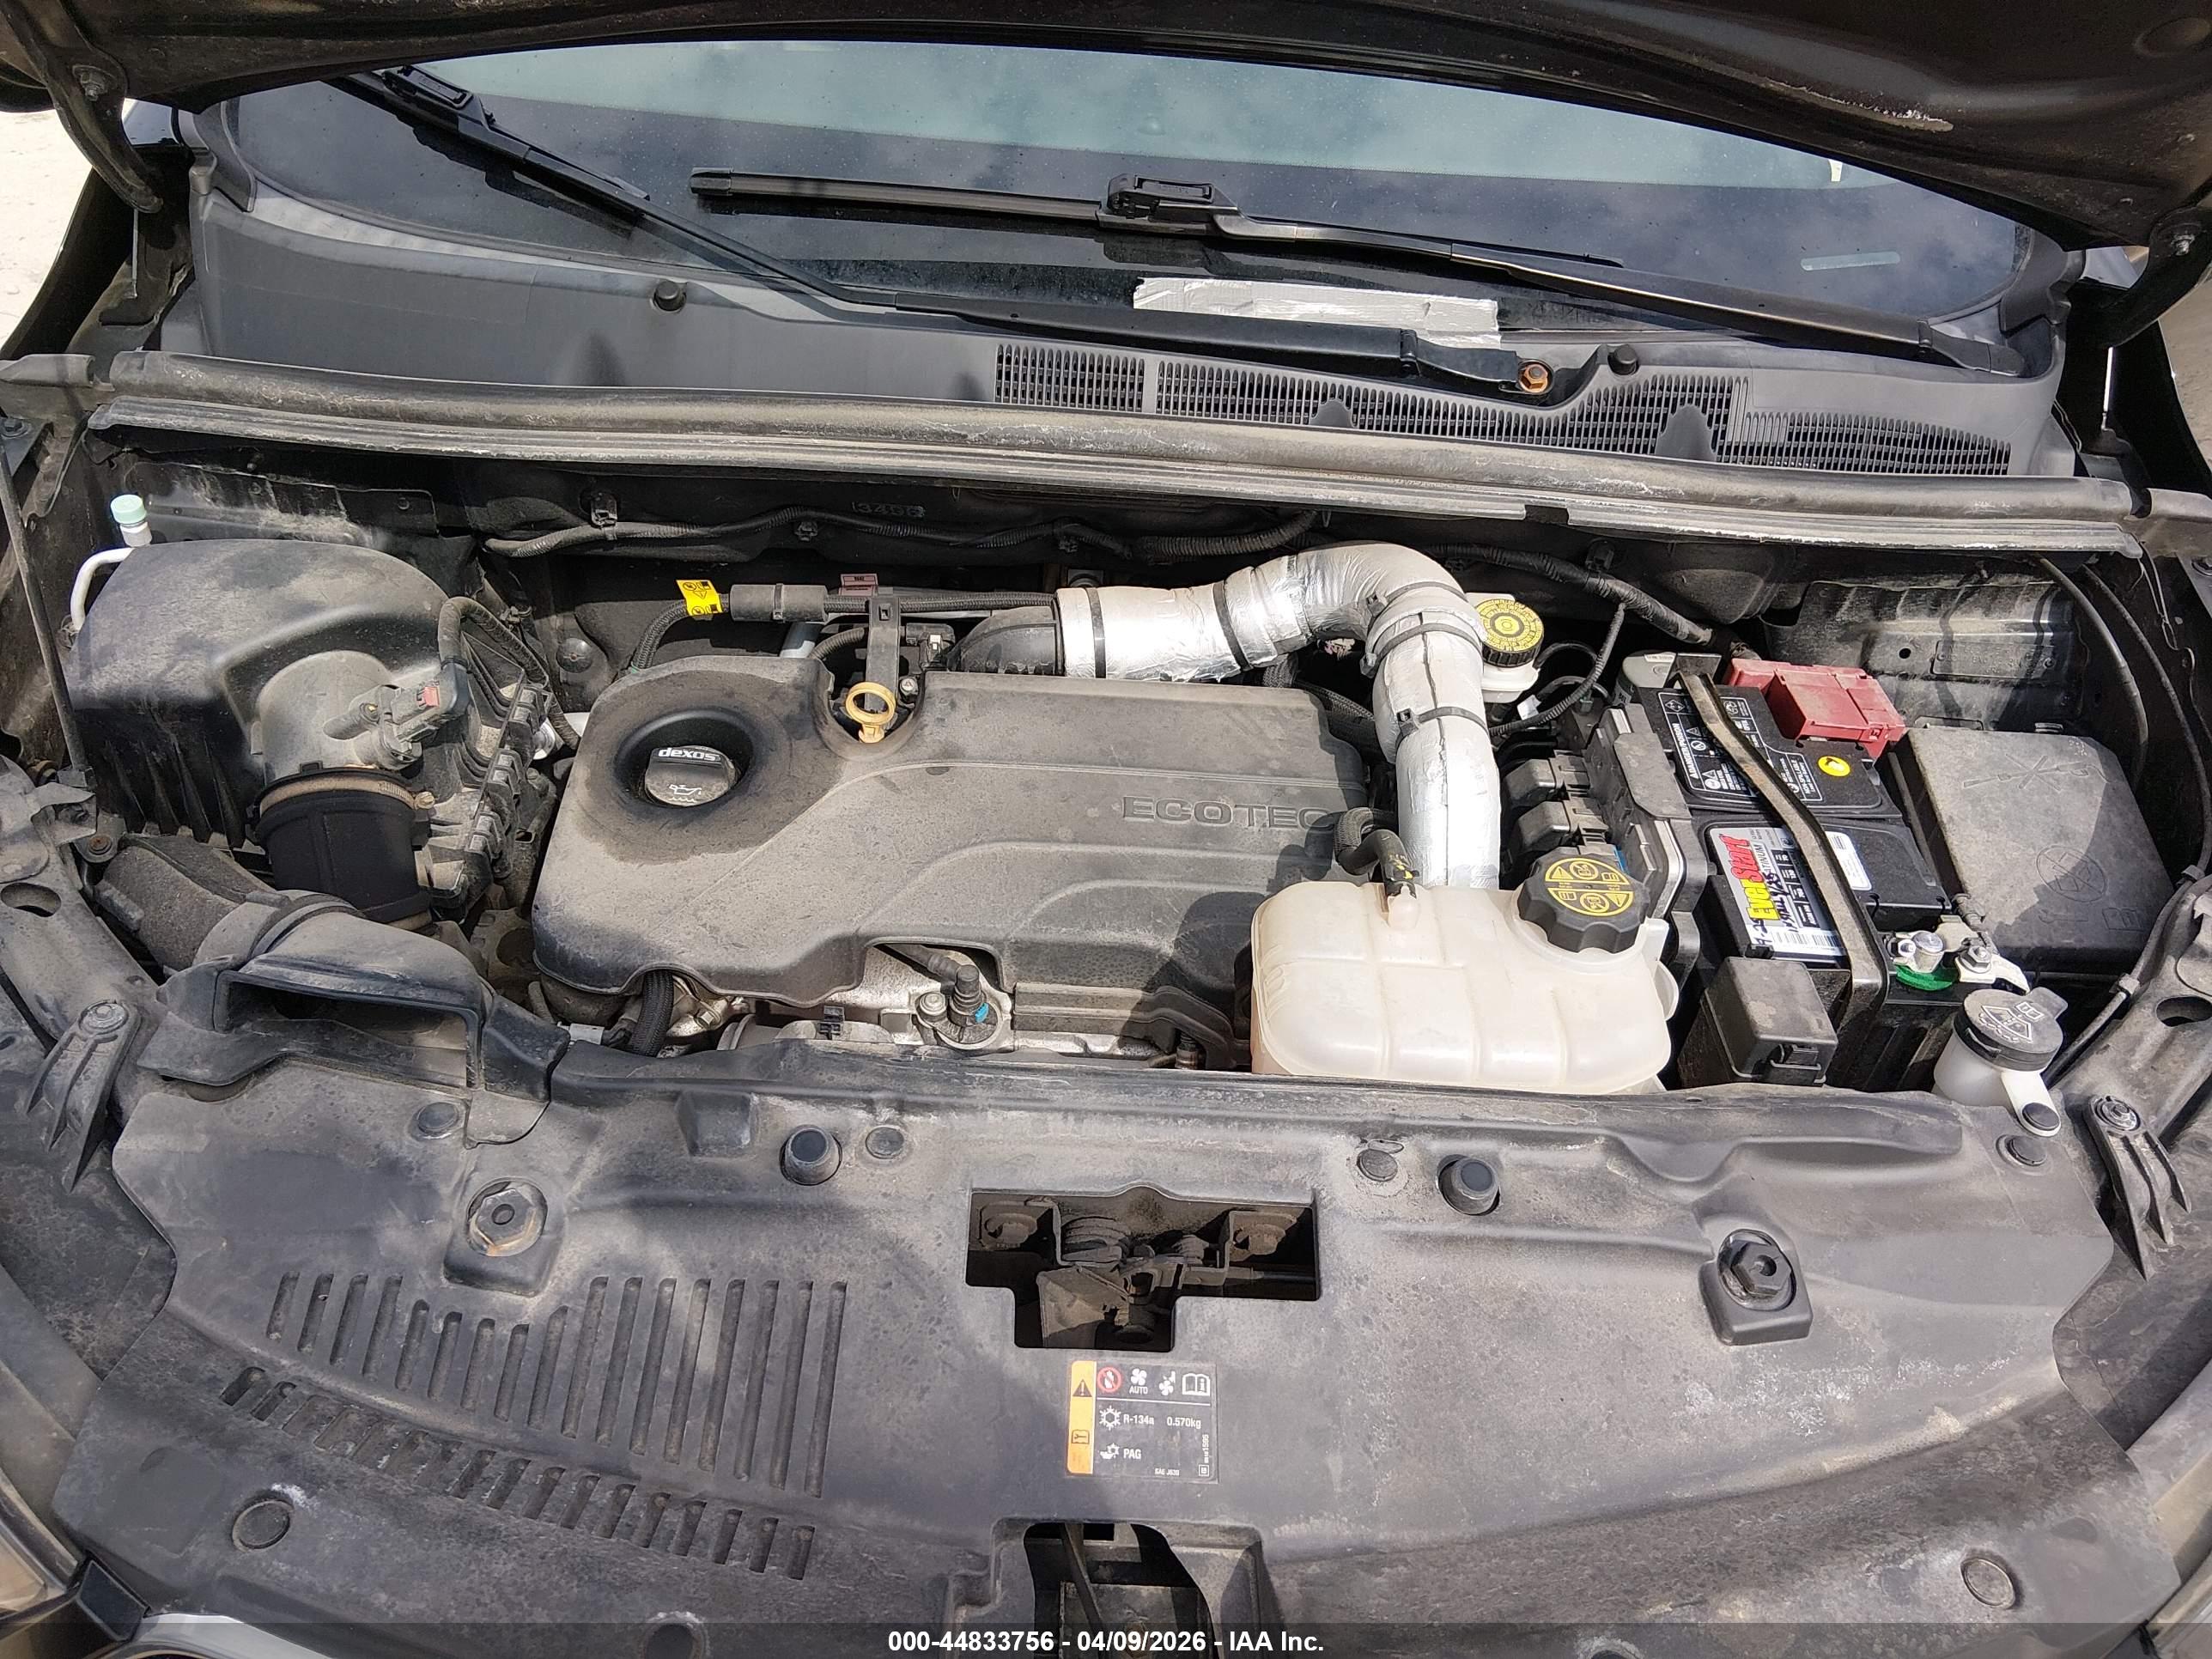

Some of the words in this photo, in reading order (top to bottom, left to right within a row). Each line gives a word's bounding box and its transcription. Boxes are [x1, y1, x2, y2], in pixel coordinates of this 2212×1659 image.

[659, 748, 720, 761] dexos
[1123, 797, 1334, 830] ECOTEC
[1718, 835, 1781, 921] EverStart
[1129, 1386, 1148, 1395] AUTO
[1123, 1414, 1155, 1425] R-134a
[1166, 1417, 1201, 1429] 0.570kg
[1123, 1449, 1142, 1459] PAG
